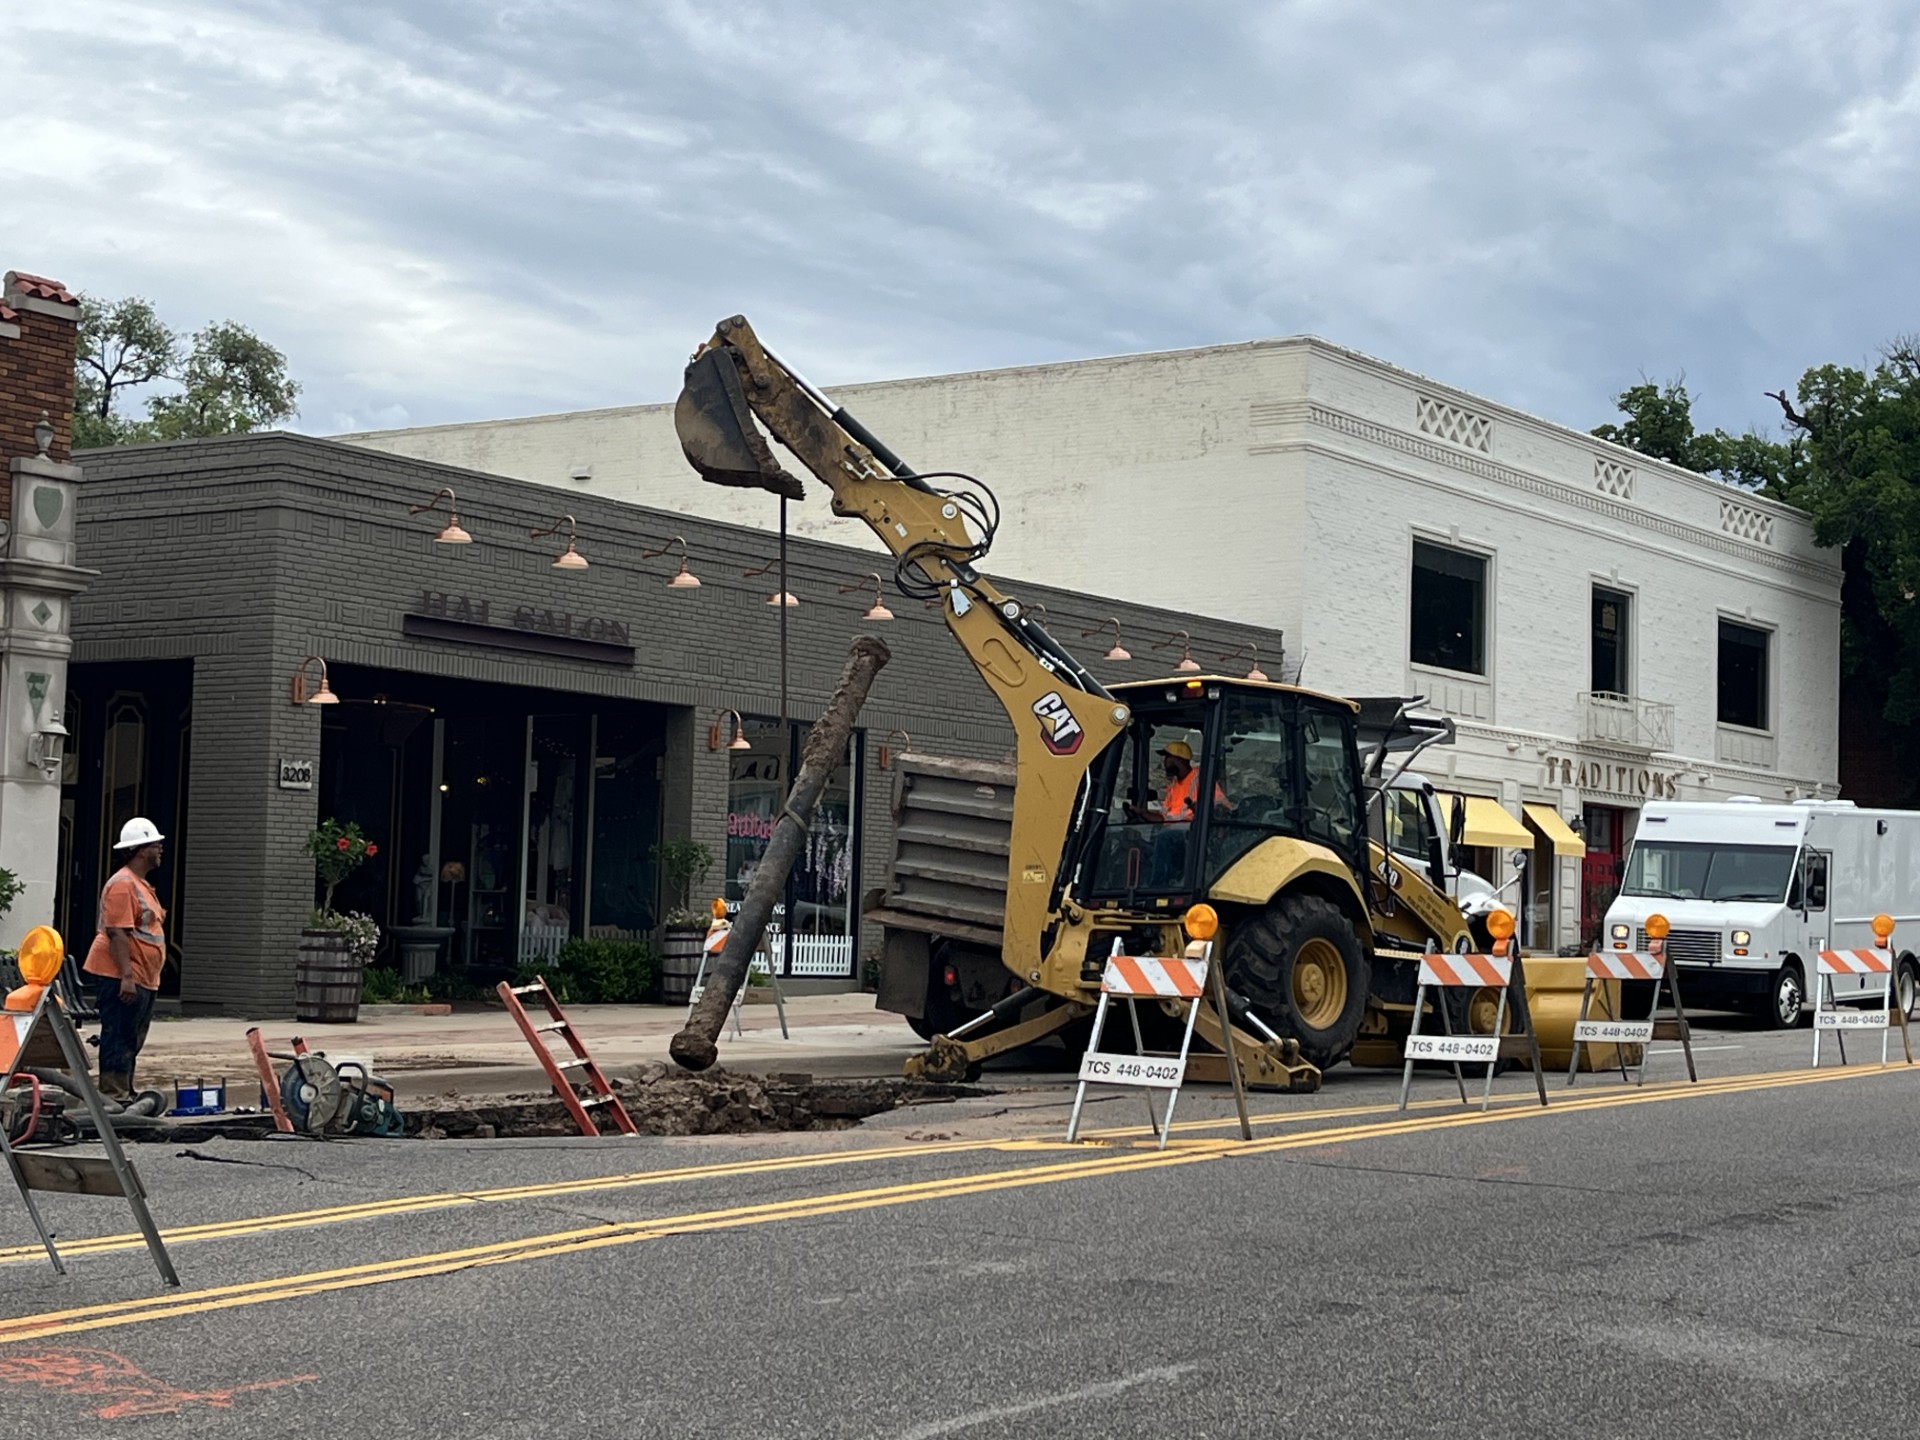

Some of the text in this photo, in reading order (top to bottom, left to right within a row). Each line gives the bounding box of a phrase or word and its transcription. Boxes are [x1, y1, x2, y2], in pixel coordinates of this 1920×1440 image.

[514, 605, 631, 645] SALON
[1032, 691, 1082, 742] CAT
[282, 766, 311, 783] 3208
[1546, 756, 1677, 799] TRADITIONS
[1819, 1014, 1886, 1025] TCS 448-0402
[1580, 1025, 1649, 1038] TCS 448-0402
[1411, 1041, 1494, 1056] TCS 448-0402
[1086, 1060, 1179, 1081] TCS 448-0402
